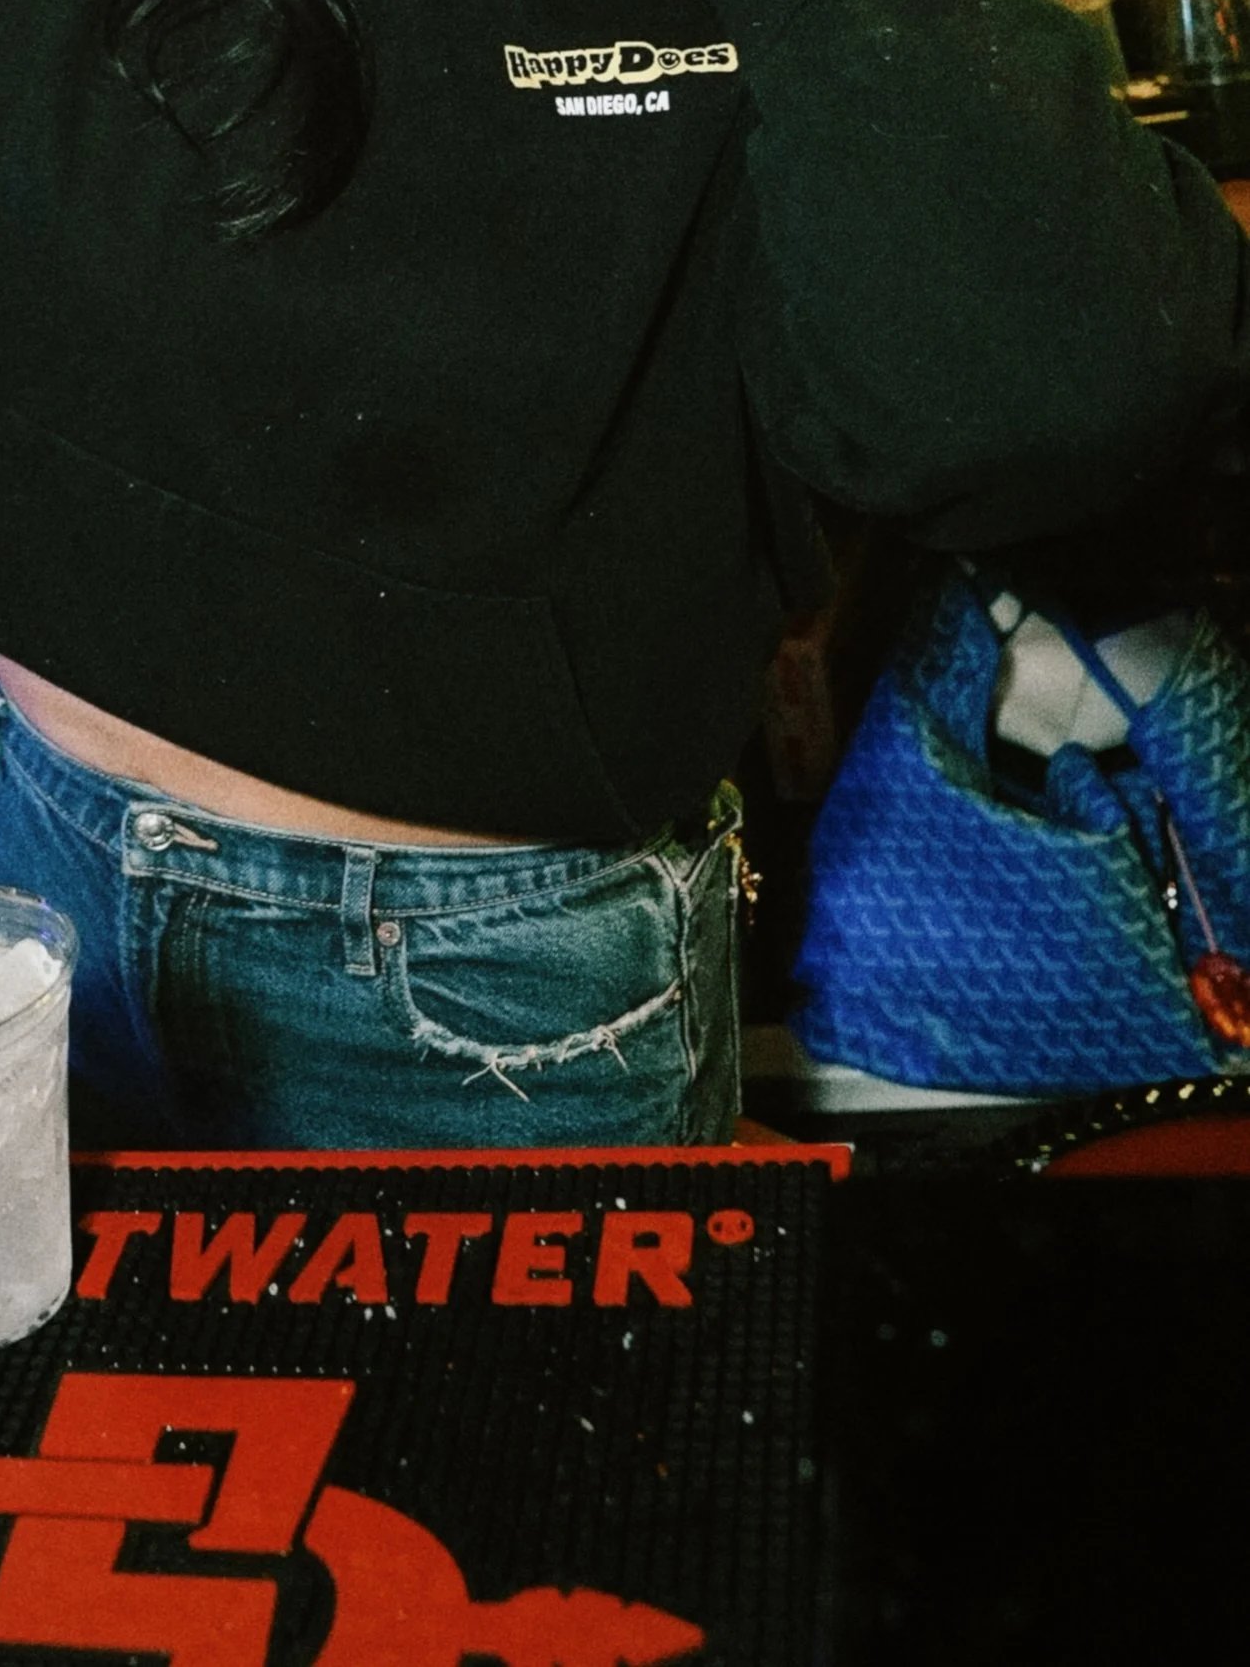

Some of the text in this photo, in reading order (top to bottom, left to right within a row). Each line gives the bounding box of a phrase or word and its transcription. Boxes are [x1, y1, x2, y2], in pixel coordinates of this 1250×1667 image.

[555, 90, 670, 116] SAN DIEGO, CA
